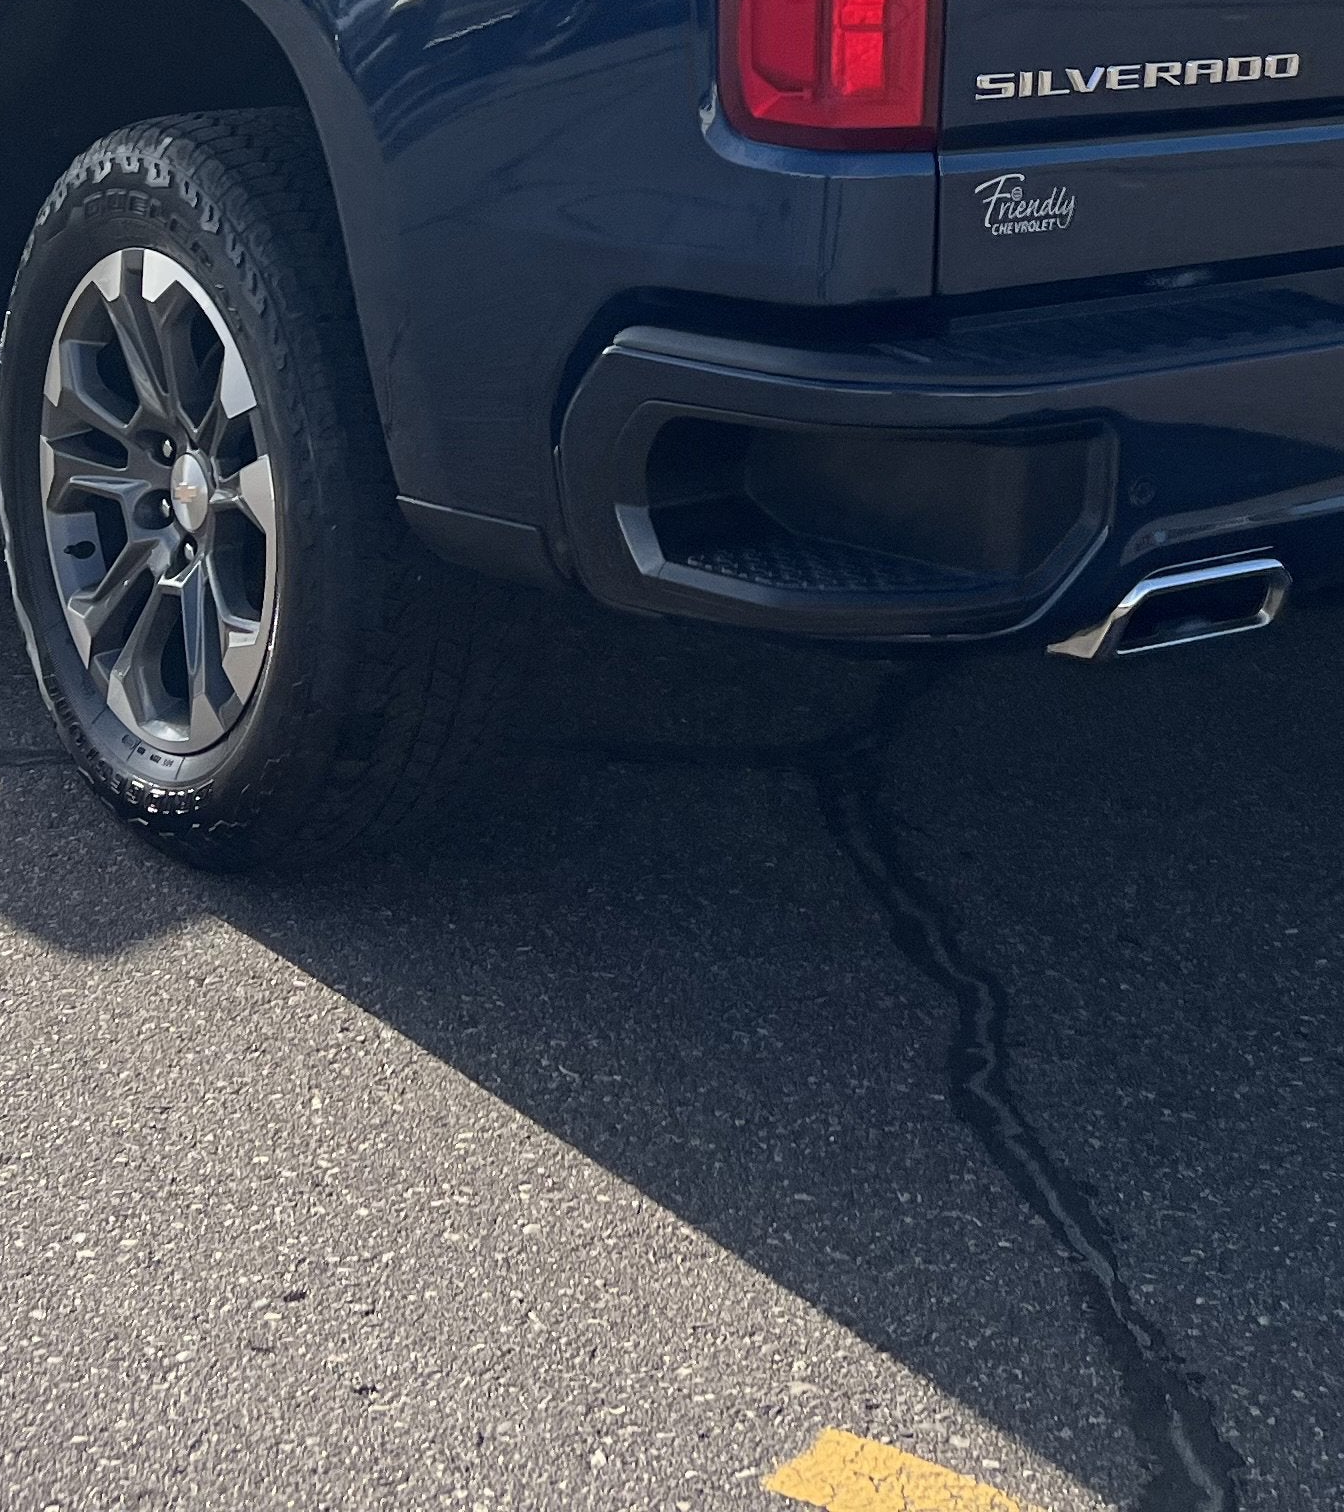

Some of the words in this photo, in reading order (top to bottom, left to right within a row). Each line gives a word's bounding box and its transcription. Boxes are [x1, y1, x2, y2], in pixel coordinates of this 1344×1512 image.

[975, 53, 1300, 101] SILVERADO
[975, 173, 1075, 228] Friendly
[992, 218, 1056, 235] CHEVROLET
